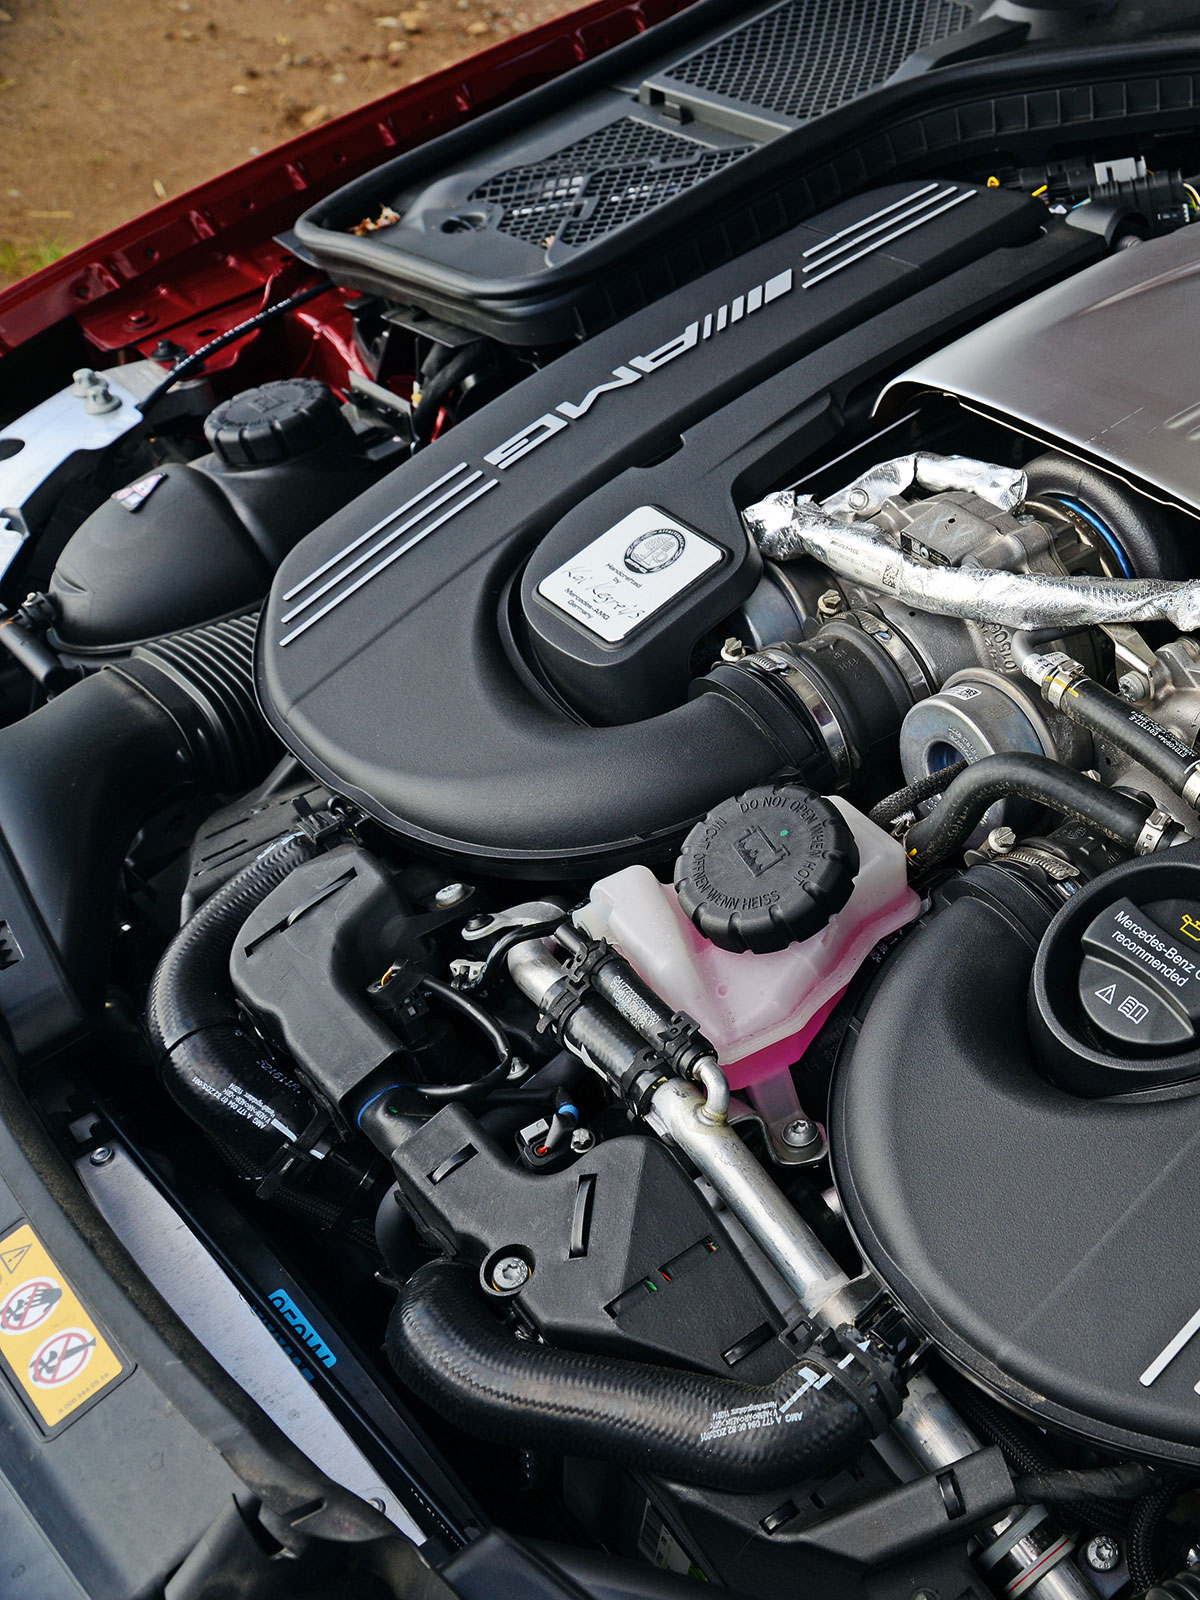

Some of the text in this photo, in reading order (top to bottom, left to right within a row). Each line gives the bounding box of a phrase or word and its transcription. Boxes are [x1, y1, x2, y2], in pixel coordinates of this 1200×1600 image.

[483, 321, 699, 470] AMG
[606, 563, 642, 589] Handcrafted
[612, 576, 622, 585] by
[564, 587, 611, 620] Mercedes-AMG
[567, 599, 593, 619] Germany
[739, 796, 825, 887] DO NOT OPEN WHEN HOT
[706, 887, 739, 910] WENN
[741, 890, 781, 911] HEISS
[1113, 910, 1196, 974] Mercedes-Benz
[1111, 930, 1190, 987] recommended
[236, 1106, 249, 1117] 177
[252, 1117, 267, 1130] AMG
[761, 1417, 775, 1427] 177
[785, 1411, 803, 1423] AMG
